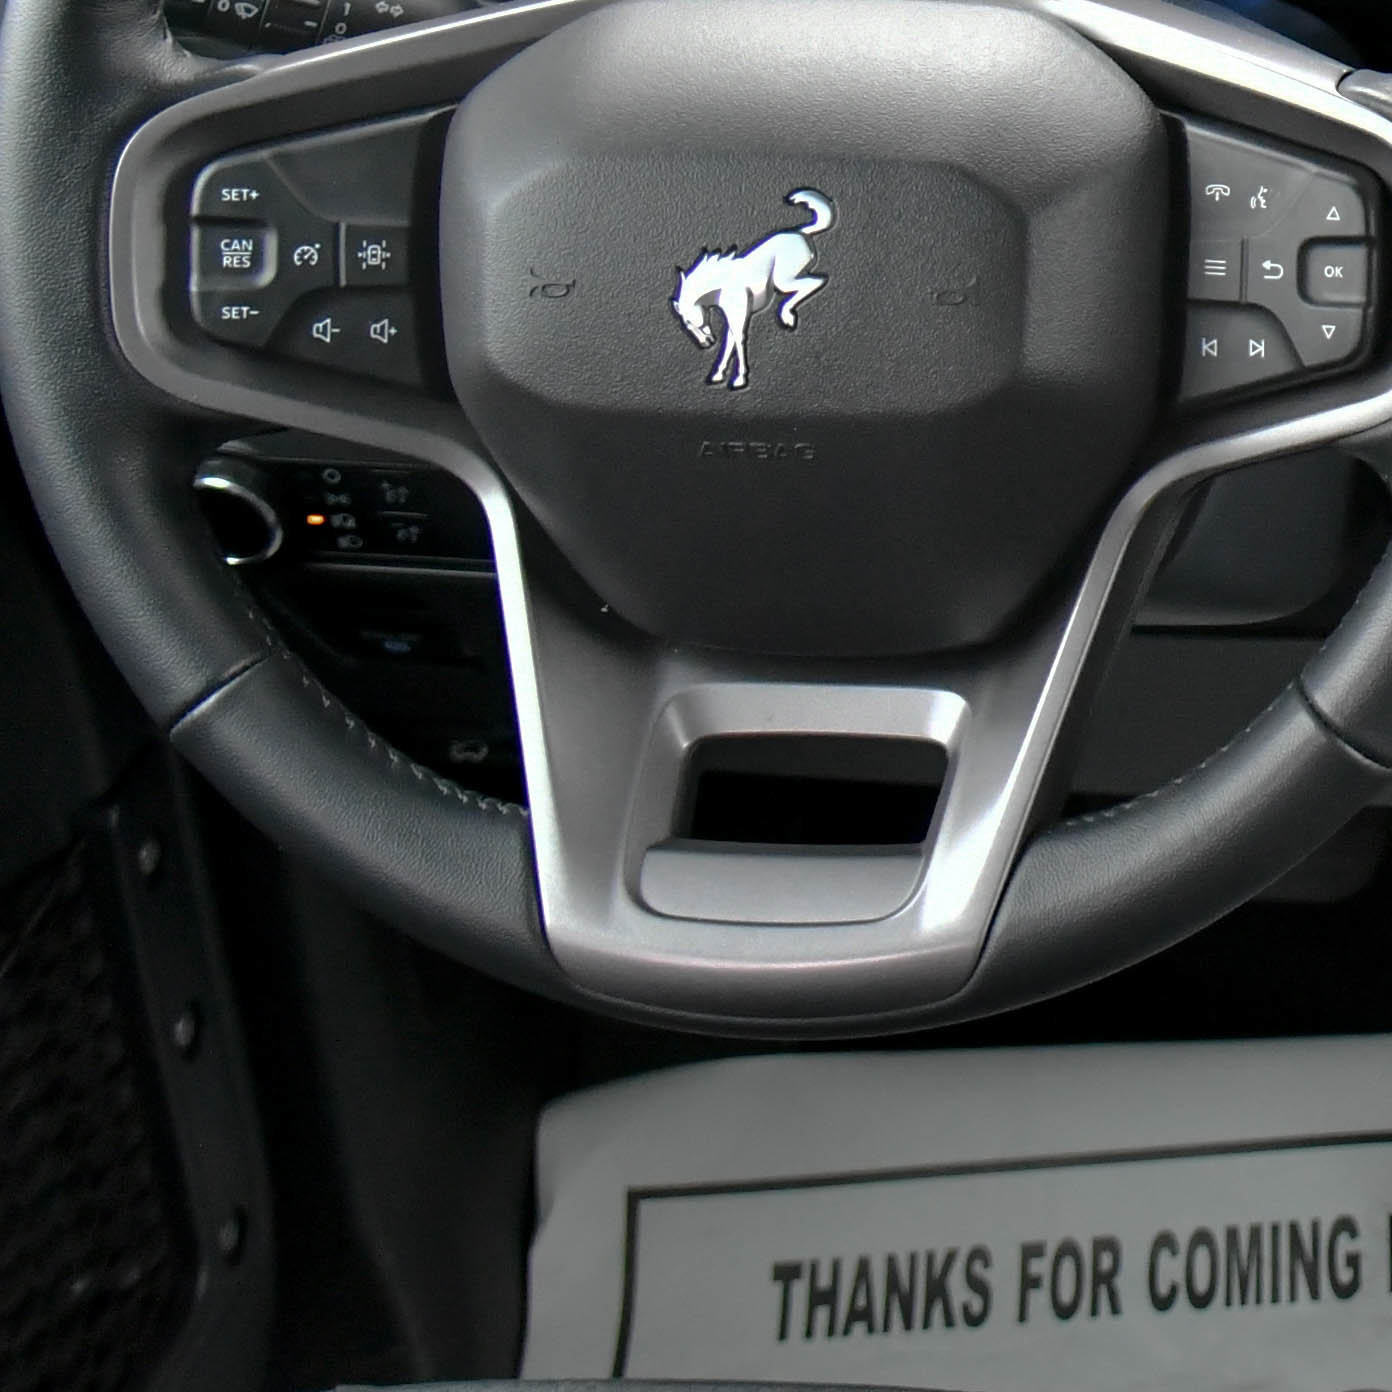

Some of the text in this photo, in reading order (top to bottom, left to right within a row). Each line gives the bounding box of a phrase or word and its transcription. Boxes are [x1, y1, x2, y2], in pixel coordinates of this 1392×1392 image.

[221, 188, 261, 202] SET+
[220, 239, 253, 251] CAN
[223, 256, 251, 268] RES
[1324, 265, 1344, 278] OK
[772, 1244, 994, 1343] THANKS
[1018, 1235, 1123, 1324] FOR
[1147, 1216, 1363, 1312] COMING
